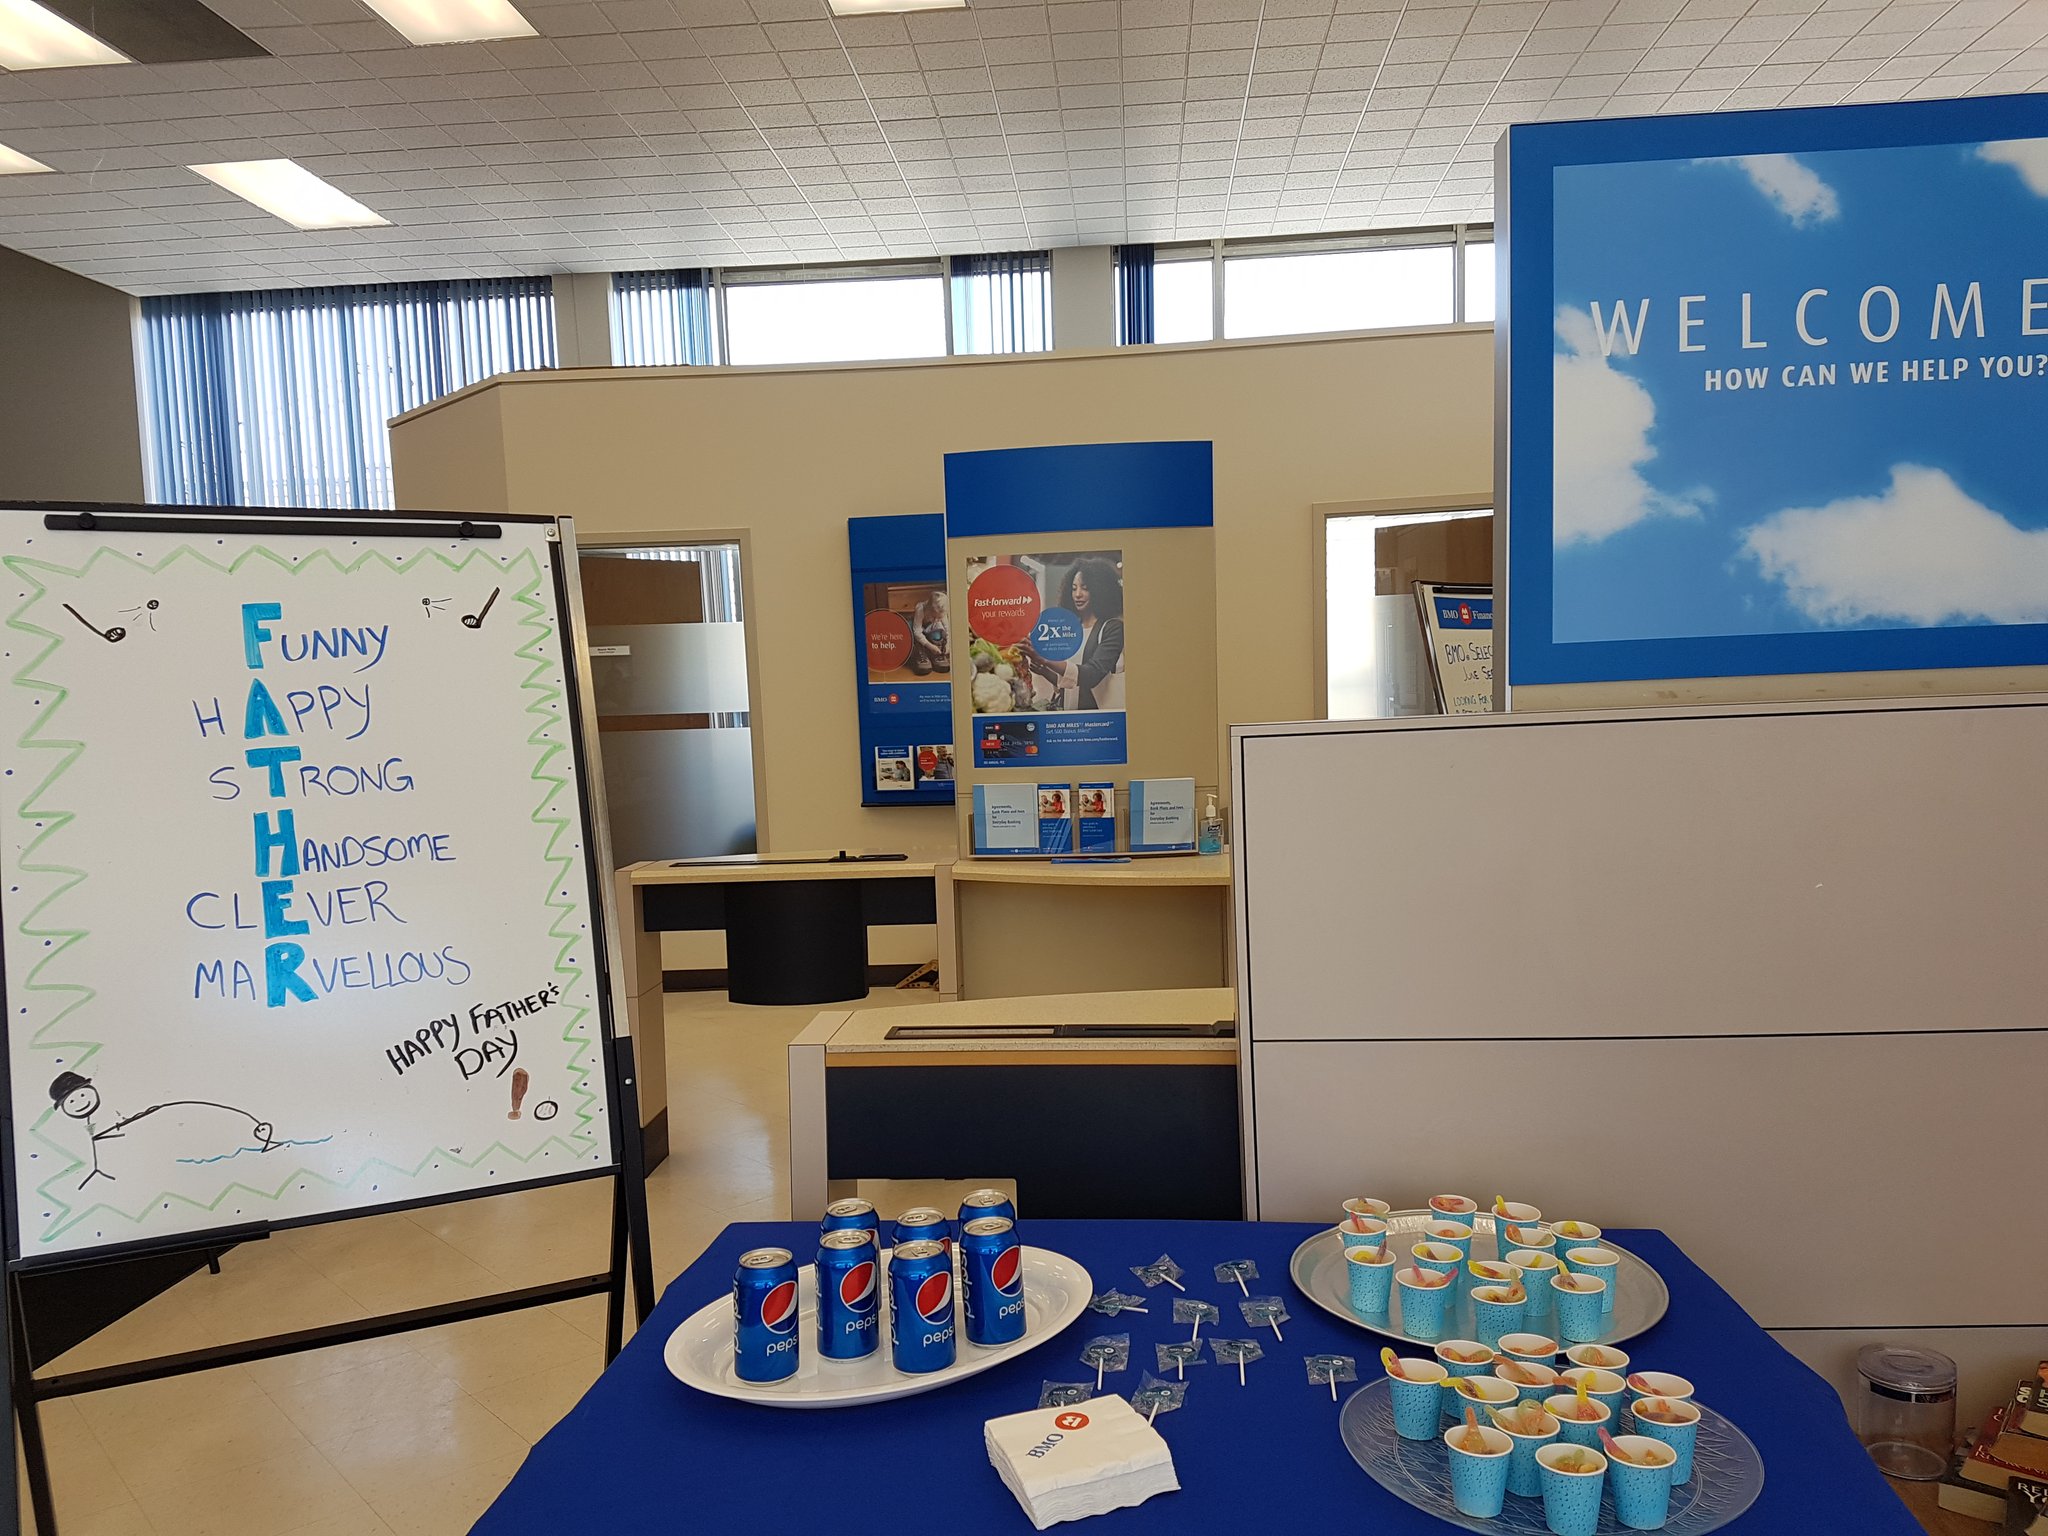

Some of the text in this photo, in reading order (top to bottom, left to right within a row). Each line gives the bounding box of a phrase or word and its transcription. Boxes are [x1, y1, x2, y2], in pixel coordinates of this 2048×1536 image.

[1590, 277, 2048, 357] WELCOME
[1704, 353, 2048, 392] HOW CAN WE HELP YOU?
[974, 596, 1022, 607] Fast-forward
[981, 608, 1025, 620] your rewards
[1442, 609, 1459, 619] BMO
[241, 602, 389, 674] FUNNY
[871, 632, 904, 641] We're here
[871, 641, 879, 649] to
[192, 677, 371, 740] HAPPY
[208, 745, 415, 800] STRONG
[253, 808, 457, 878] HANDSOME
[186, 879, 408, 940] CLEVER
[194, 942, 471, 1008] MARVELLOUS
[385, 1013, 461, 1076] HAPPY
[454, 1029, 518, 1081] DAY
[1026, 1432, 1065, 1459] BMO
